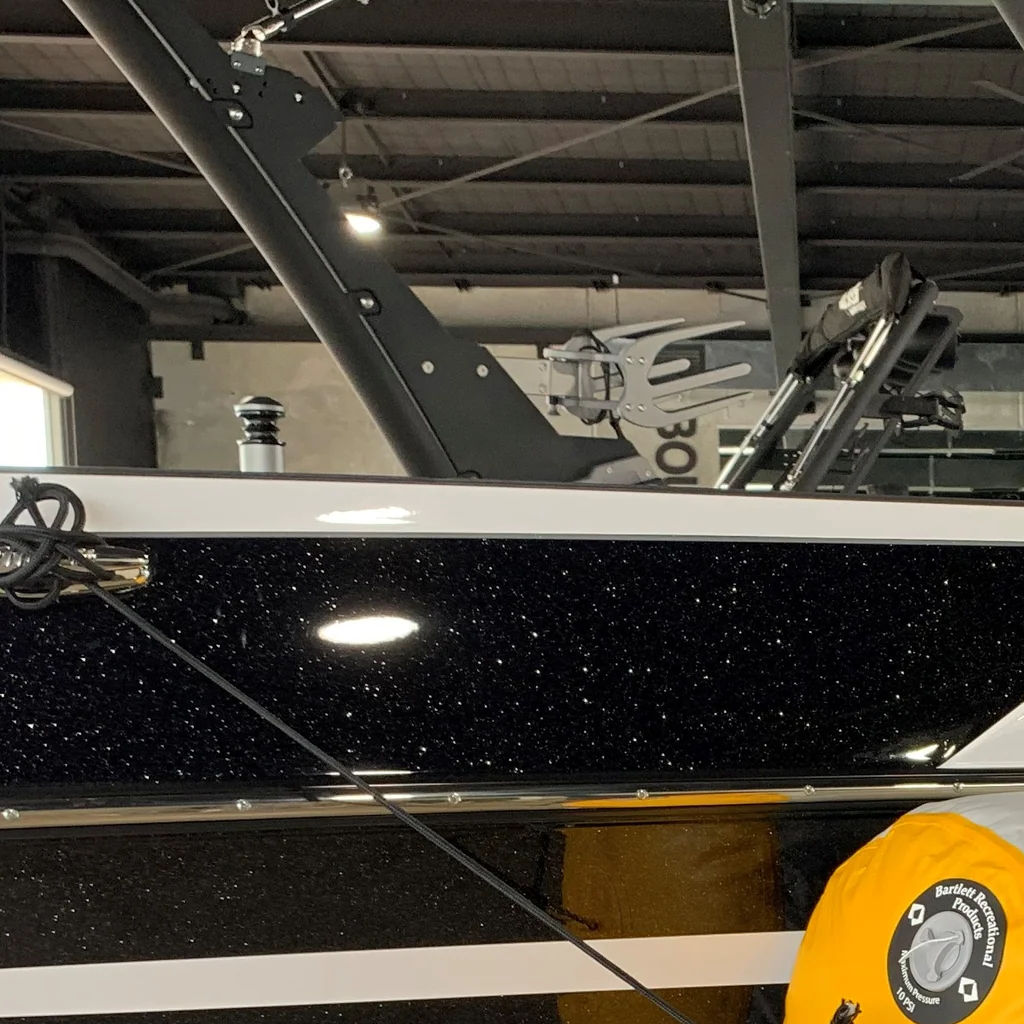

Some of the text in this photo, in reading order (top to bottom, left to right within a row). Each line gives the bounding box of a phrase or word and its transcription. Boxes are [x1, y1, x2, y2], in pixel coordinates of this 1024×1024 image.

[935, 883, 1000, 968] Bartlett Recreational
[952, 897, 984, 940] Products
[896, 986, 916, 1013] 10 PSI
[912, 987, 940, 1005] Pressure
